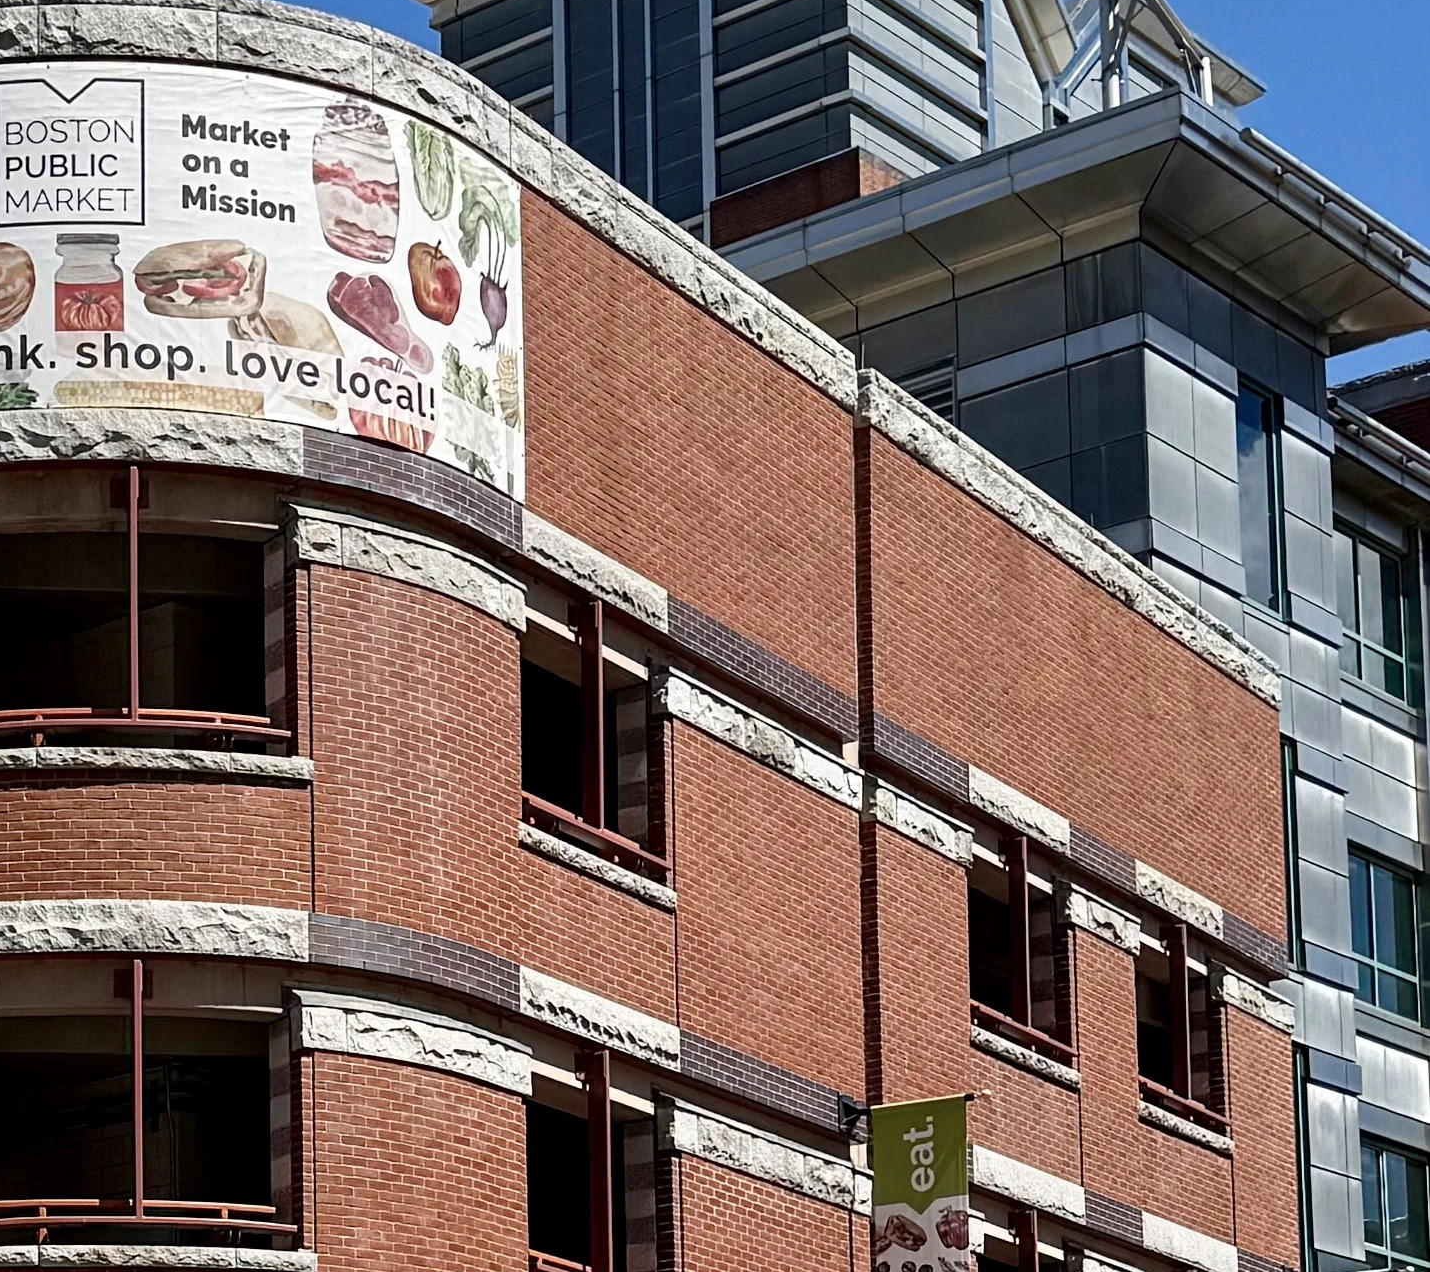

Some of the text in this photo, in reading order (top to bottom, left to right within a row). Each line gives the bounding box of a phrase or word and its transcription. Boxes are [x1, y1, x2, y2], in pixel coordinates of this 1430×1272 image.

[5, 119, 135, 145] BOSTON
[181, 113, 292, 152] Market
[5, 154, 119, 180] PUBLIC
[181, 153, 249, 178] on a
[5, 187, 136, 214] MARKET
[181, 184, 296, 224] Mission
[75, 333, 206, 382] shop.
[225, 341, 320, 388] love
[336, 359, 436, 421] local!
[902, 1115, 936, 1193] eat.
